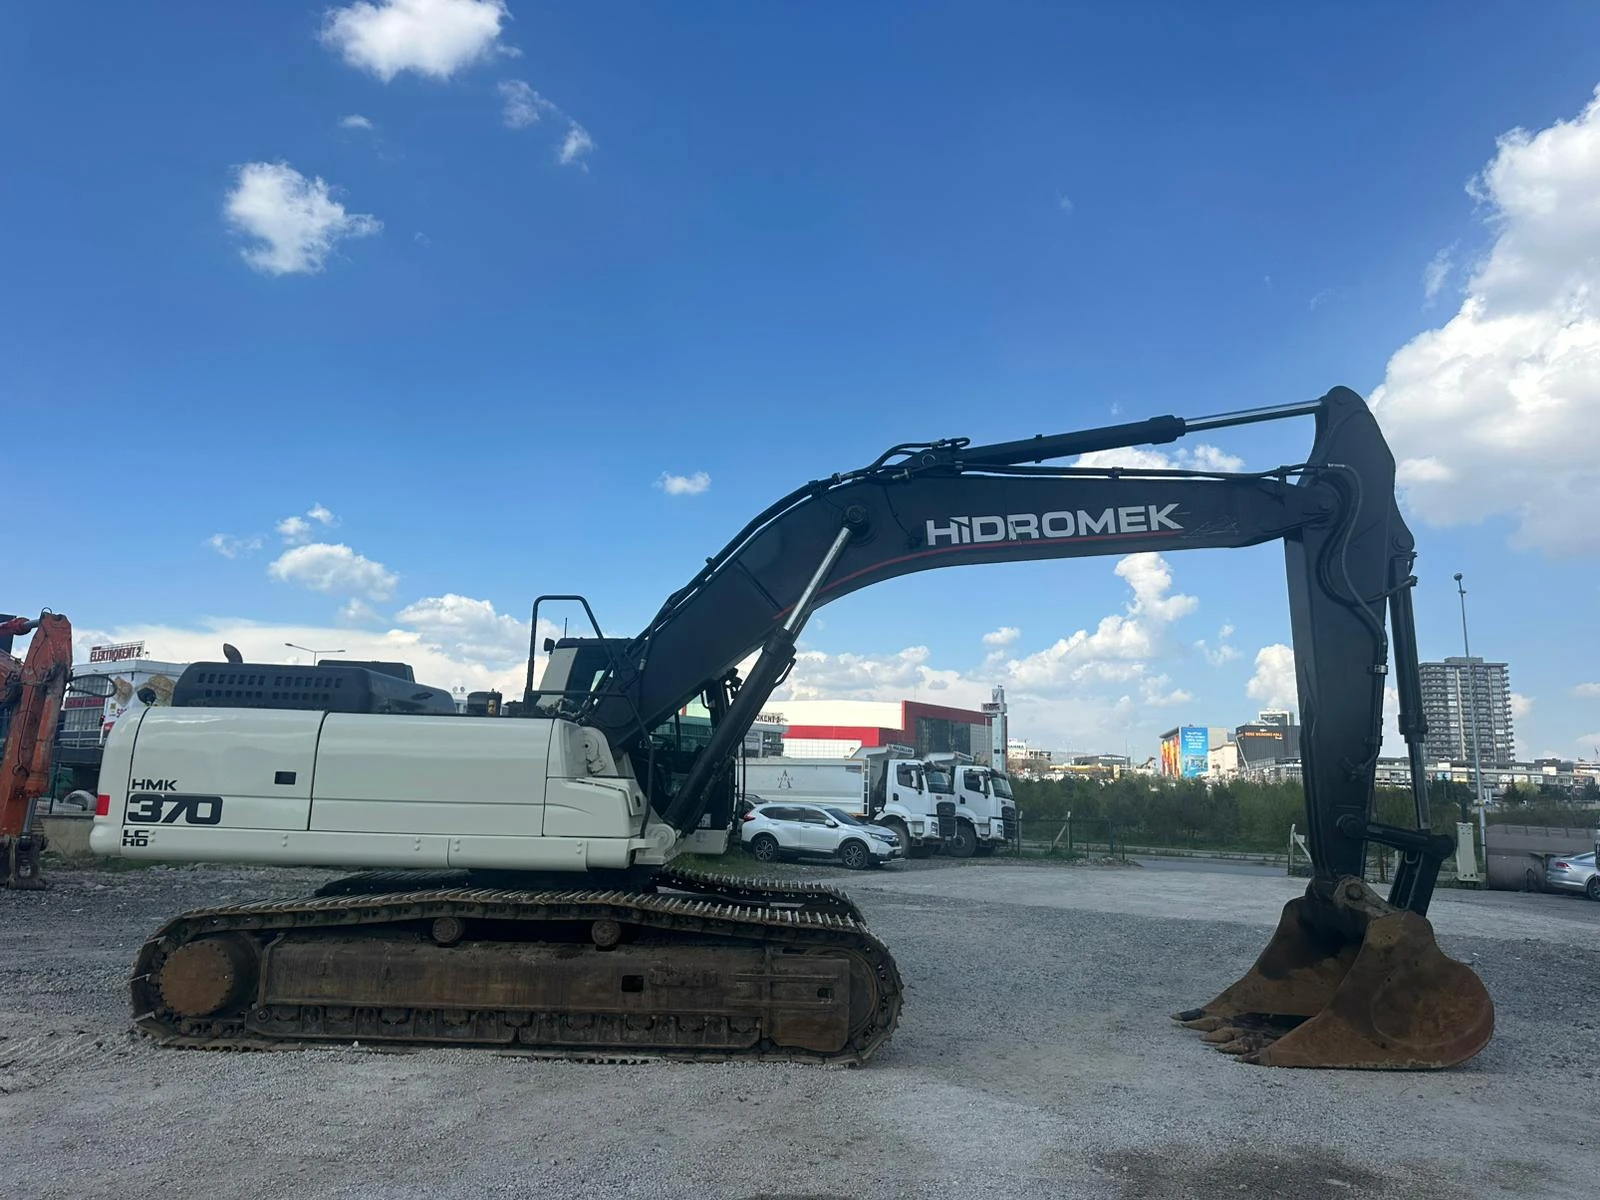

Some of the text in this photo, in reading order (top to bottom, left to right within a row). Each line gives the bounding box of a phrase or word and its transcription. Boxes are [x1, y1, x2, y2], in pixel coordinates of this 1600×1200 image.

[131, 779, 178, 791] HMK
[128, 793, 223, 825] 370
[123, 829, 149, 838] LC
[122, 838, 148, 847] HD
